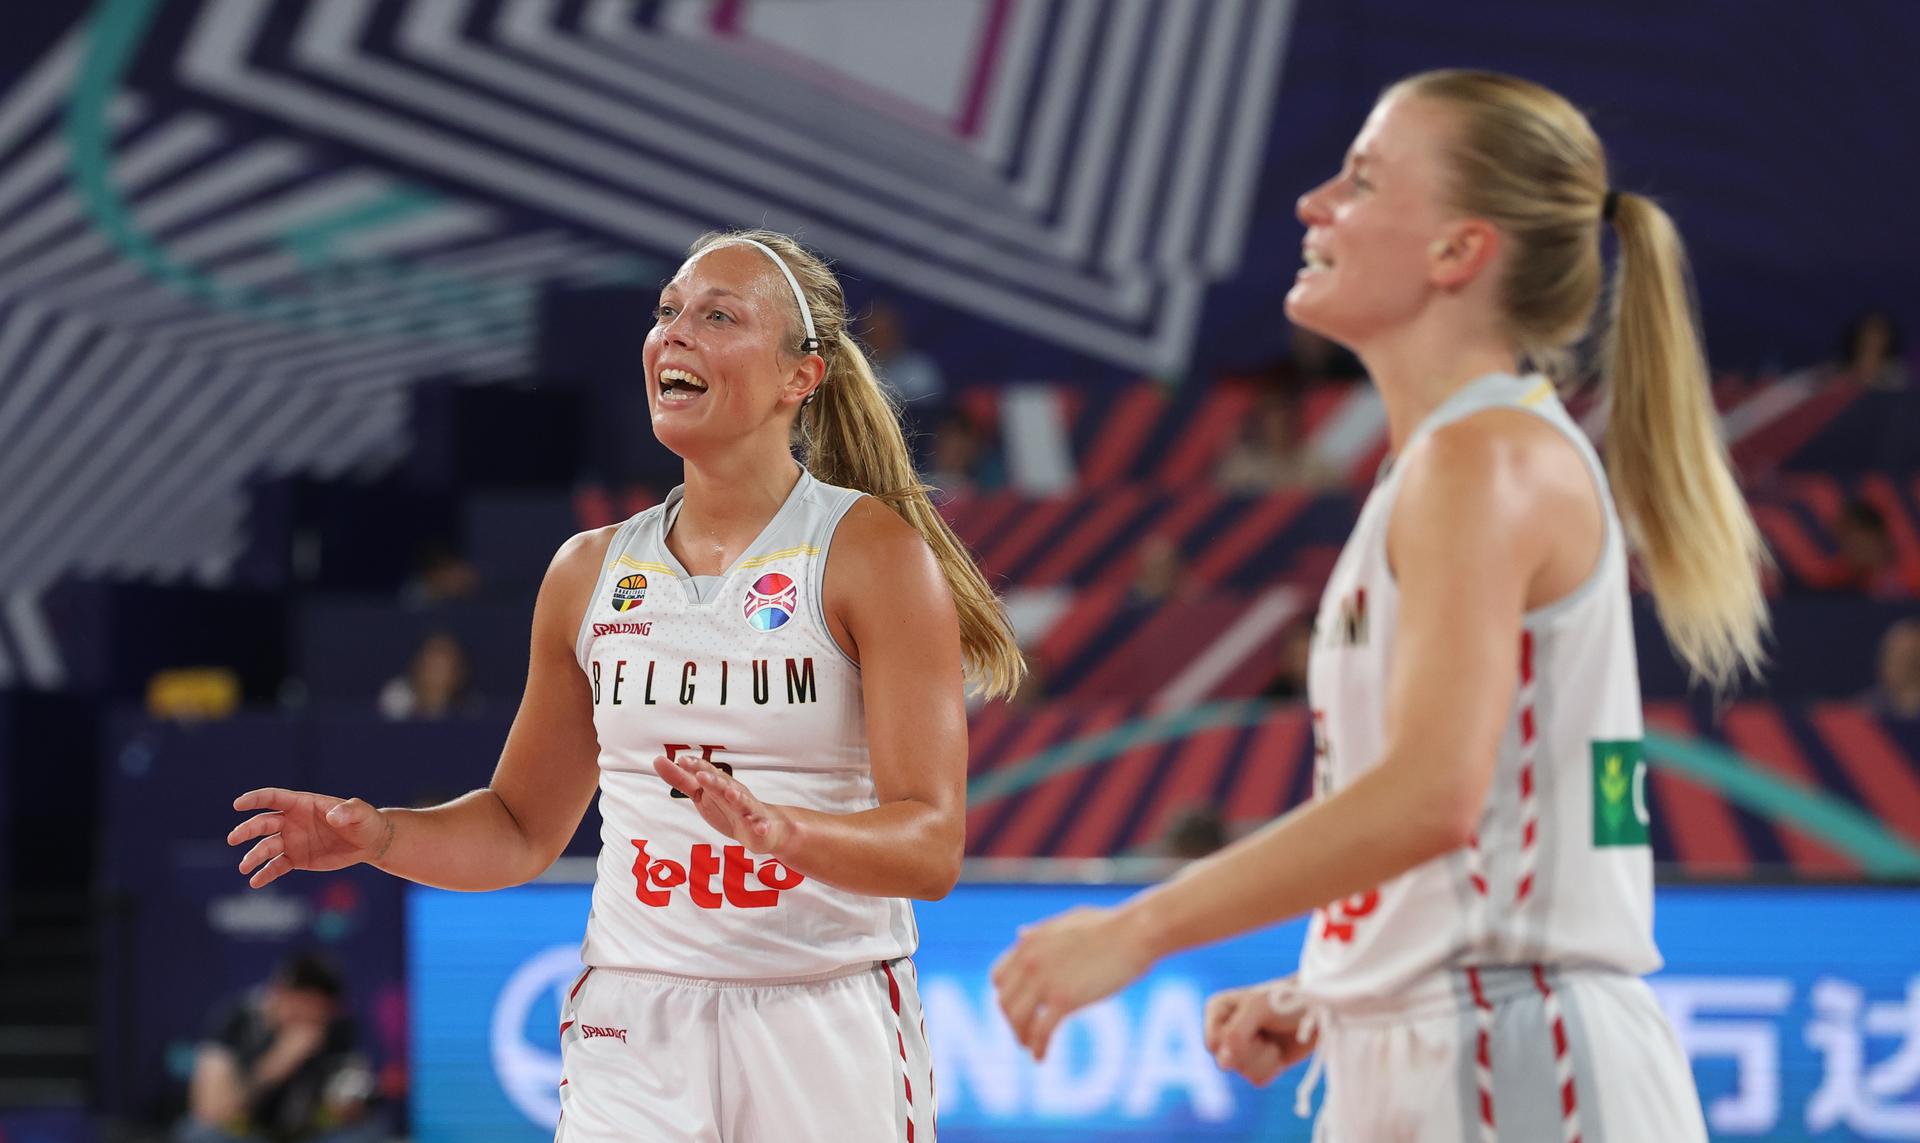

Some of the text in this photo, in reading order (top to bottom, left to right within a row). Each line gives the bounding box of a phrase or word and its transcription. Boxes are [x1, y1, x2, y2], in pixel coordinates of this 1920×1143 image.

[592, 622, 653, 637] SPALDING
[592, 657, 816, 706] BELGIUM
[631, 839, 805, 909] lotto
